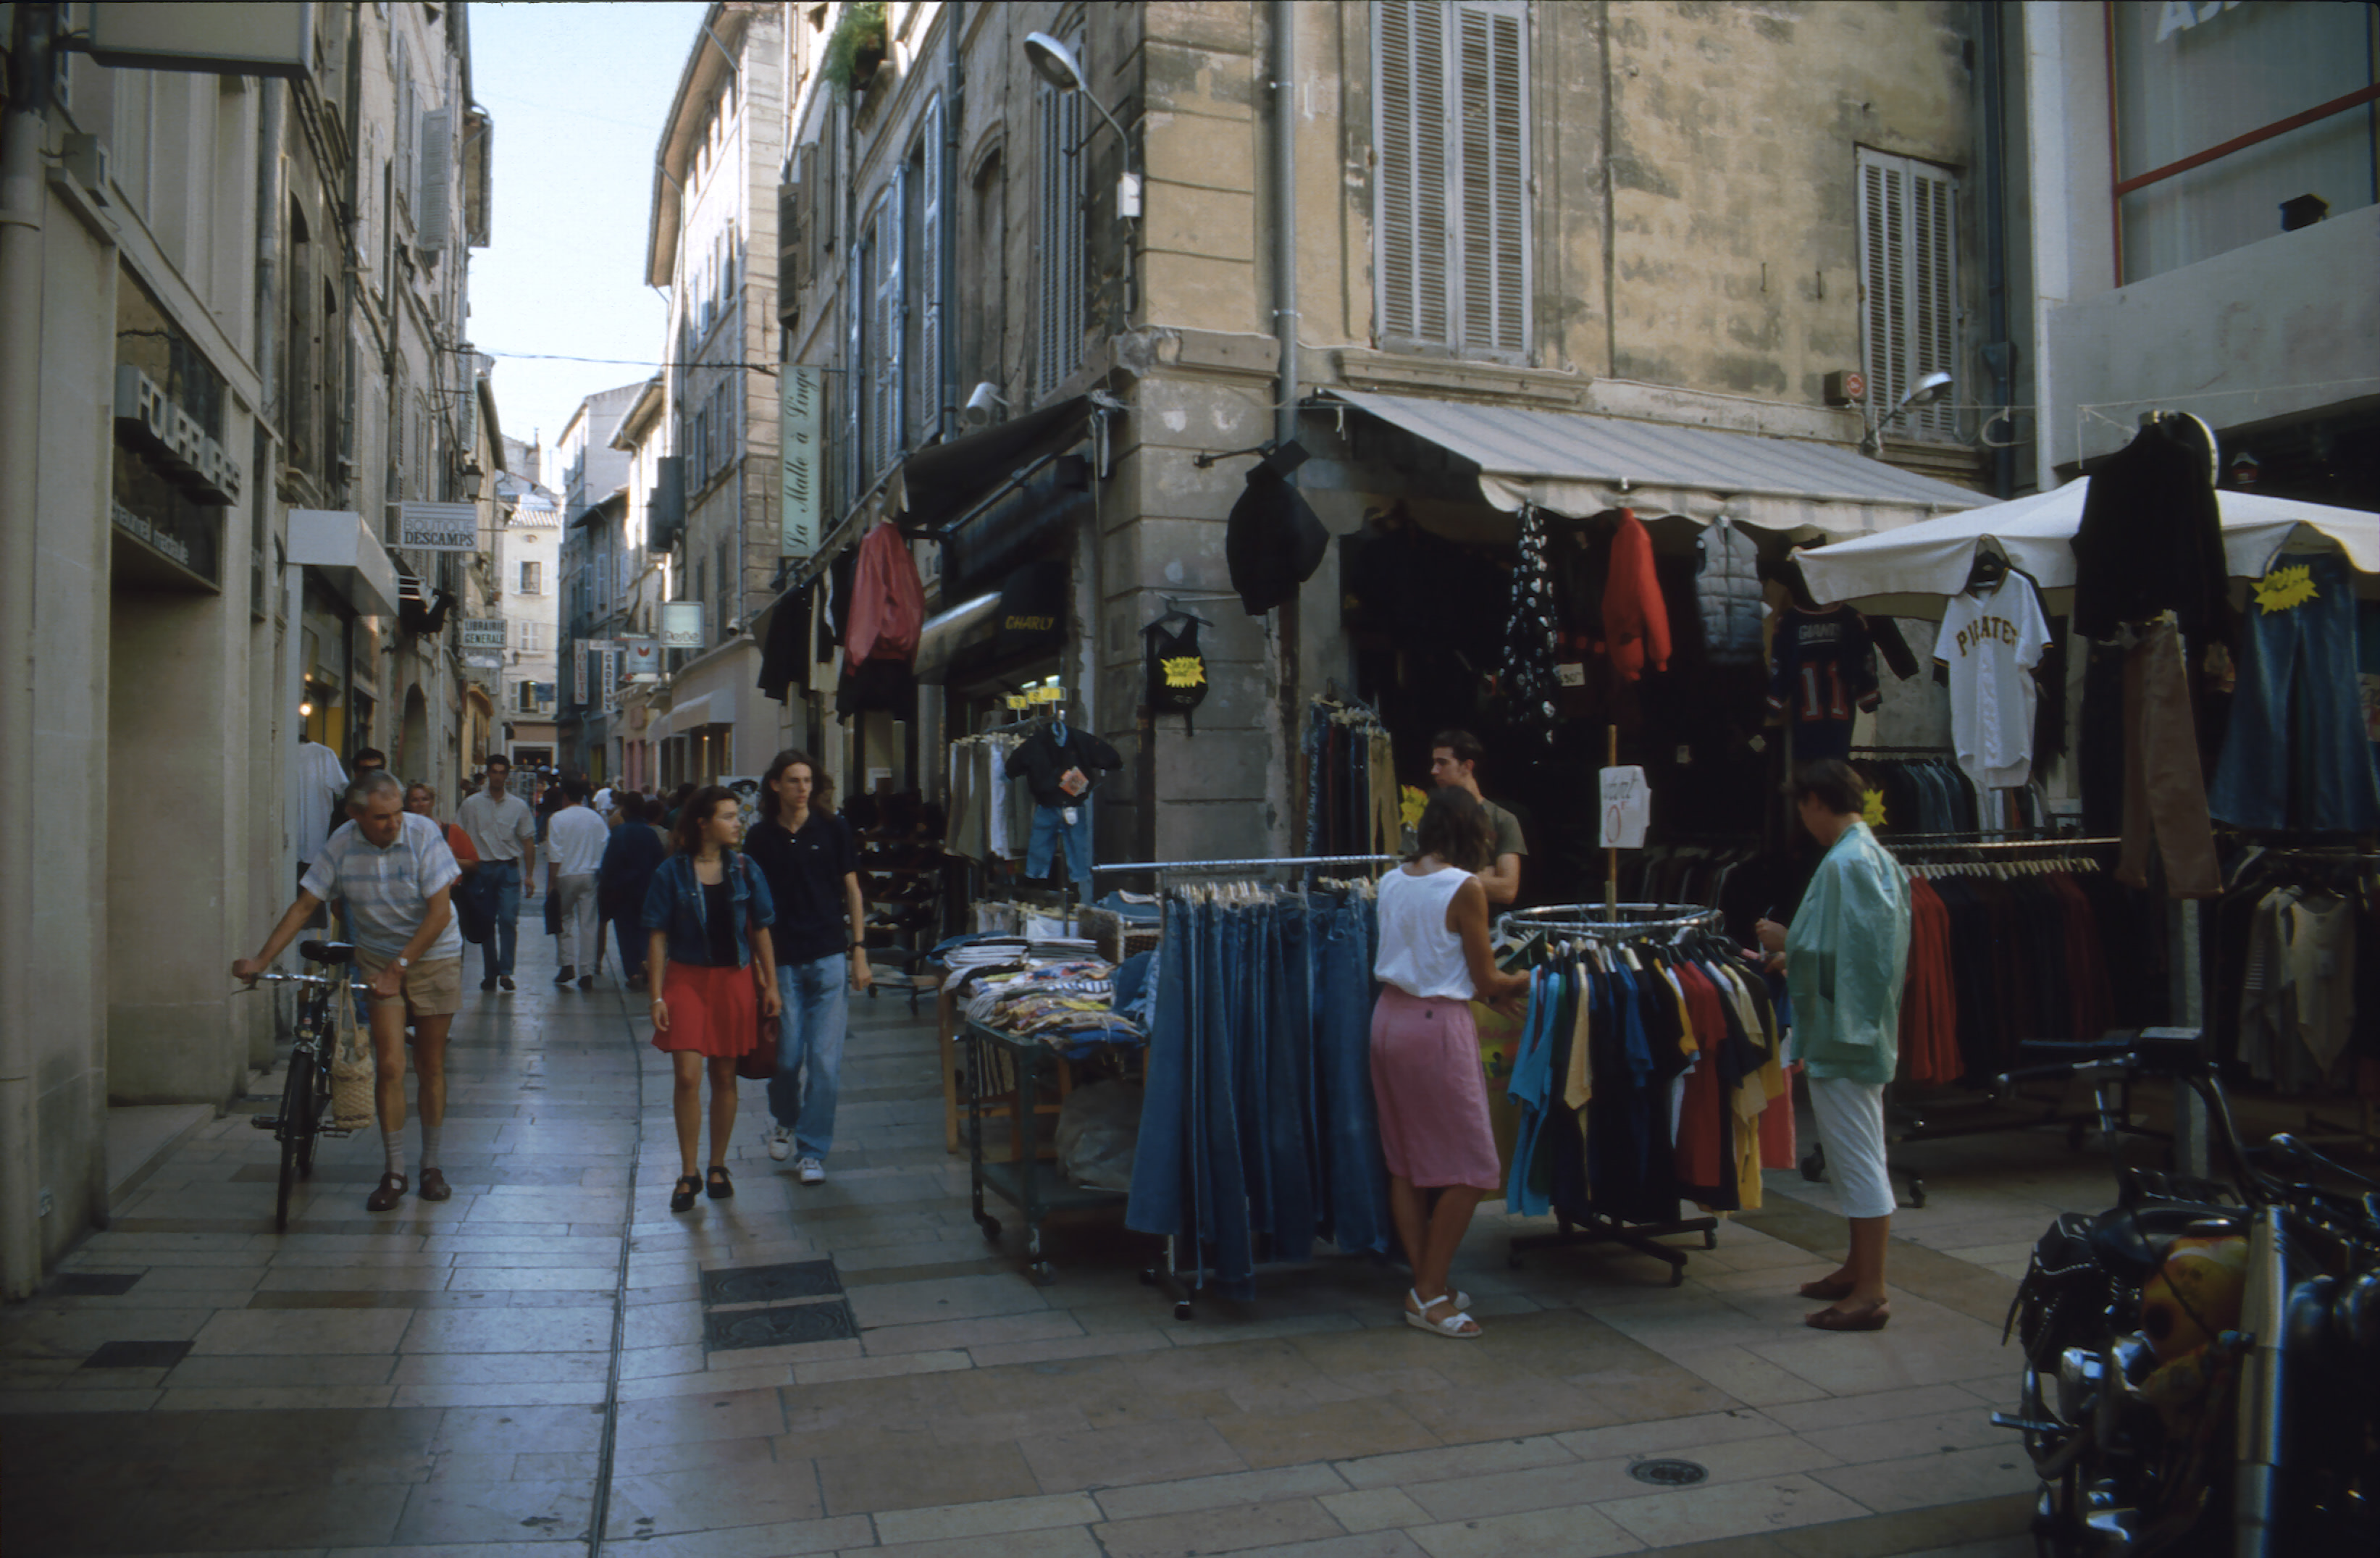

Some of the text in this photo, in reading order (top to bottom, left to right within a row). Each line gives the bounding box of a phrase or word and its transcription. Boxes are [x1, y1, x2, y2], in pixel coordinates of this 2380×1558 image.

[784, 368, 819, 420] Linge
[784, 456, 808, 514] Malle
[403, 519, 474, 532] BOUTIQUE
[785, 524, 808, 548] La
[404, 532, 474, 547] DESCAMPS
[464, 621, 505, 632] LIBRAIRIE
[1005, 615, 1055, 631] CHARLY
[464, 633, 505, 645] GENERALE
[577, 642, 587, 700] JOUETS
[605, 654, 613, 712] CADEAUX
[1801, 661, 1848, 721] 11
